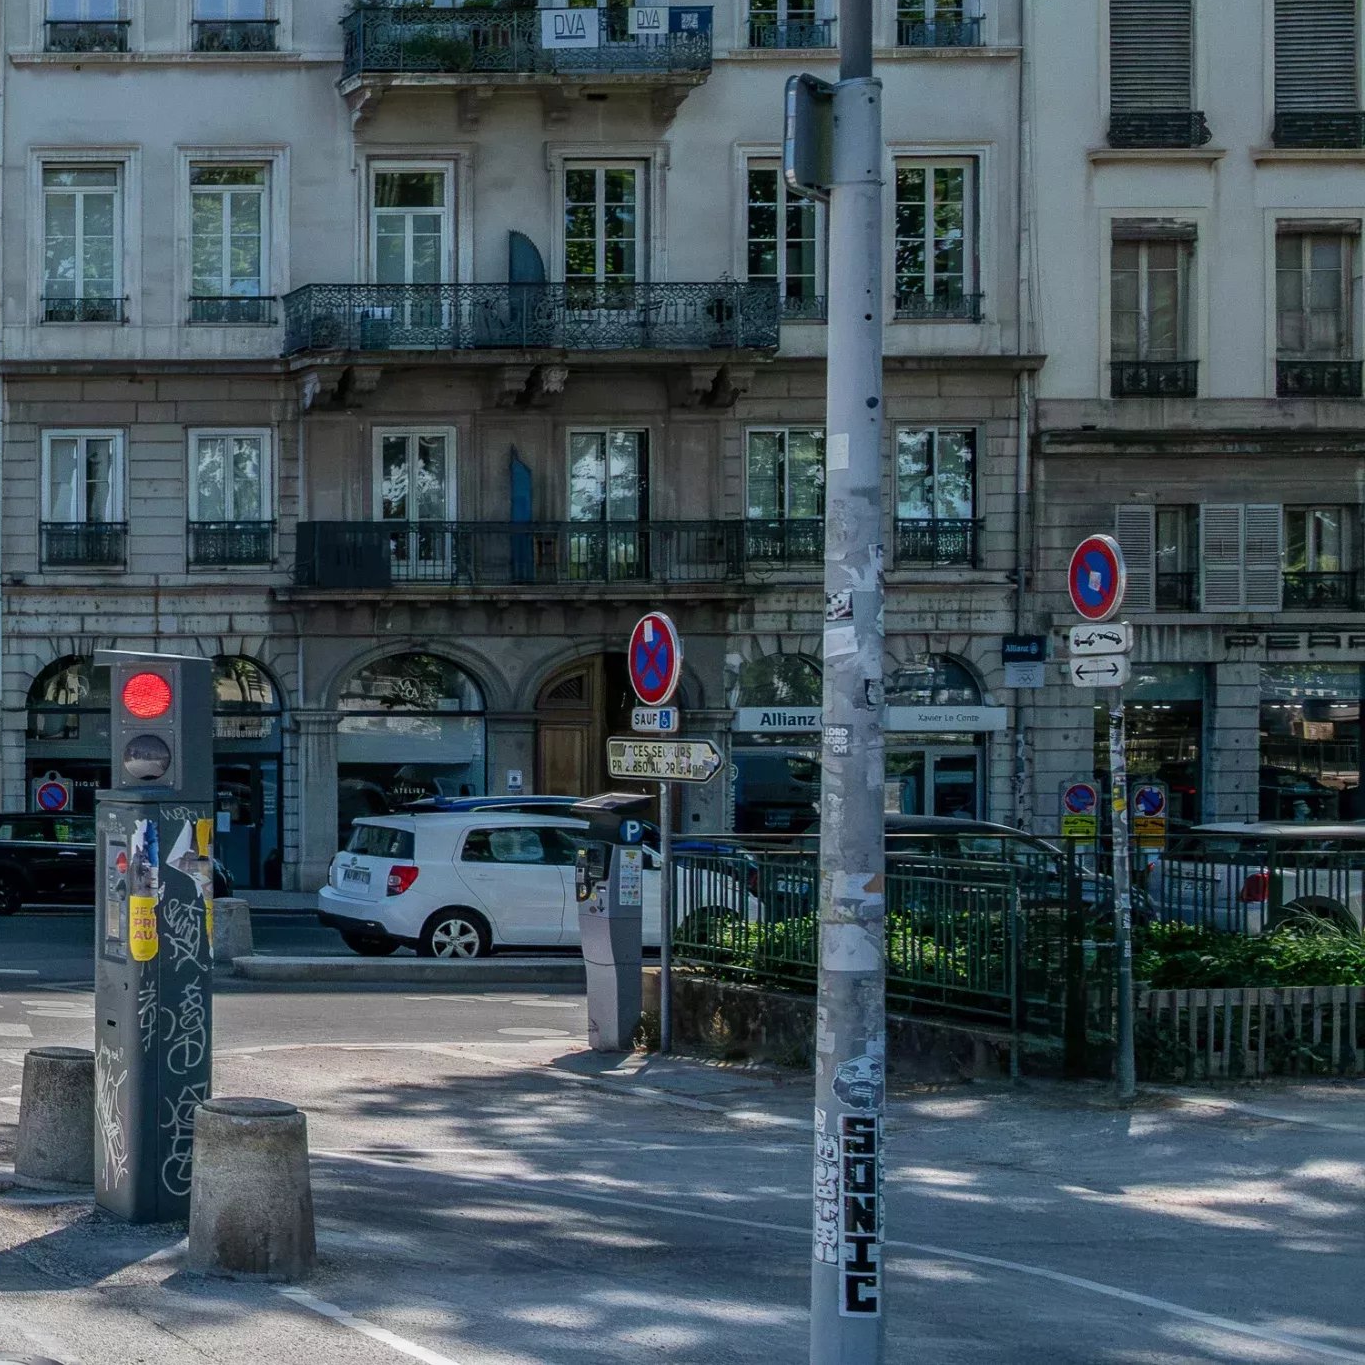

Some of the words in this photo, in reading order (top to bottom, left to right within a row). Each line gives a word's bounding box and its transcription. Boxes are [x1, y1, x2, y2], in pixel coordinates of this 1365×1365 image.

[554, 14, 586, 34] DVA
[637, 10, 660, 26] DVA
[634, 713, 658, 725] SAUF
[760, 712, 816, 727] Allianz
[918, 714, 942, 722] Xavier
[944, 714, 954, 722] Le
[626, 820, 640, 842] P
